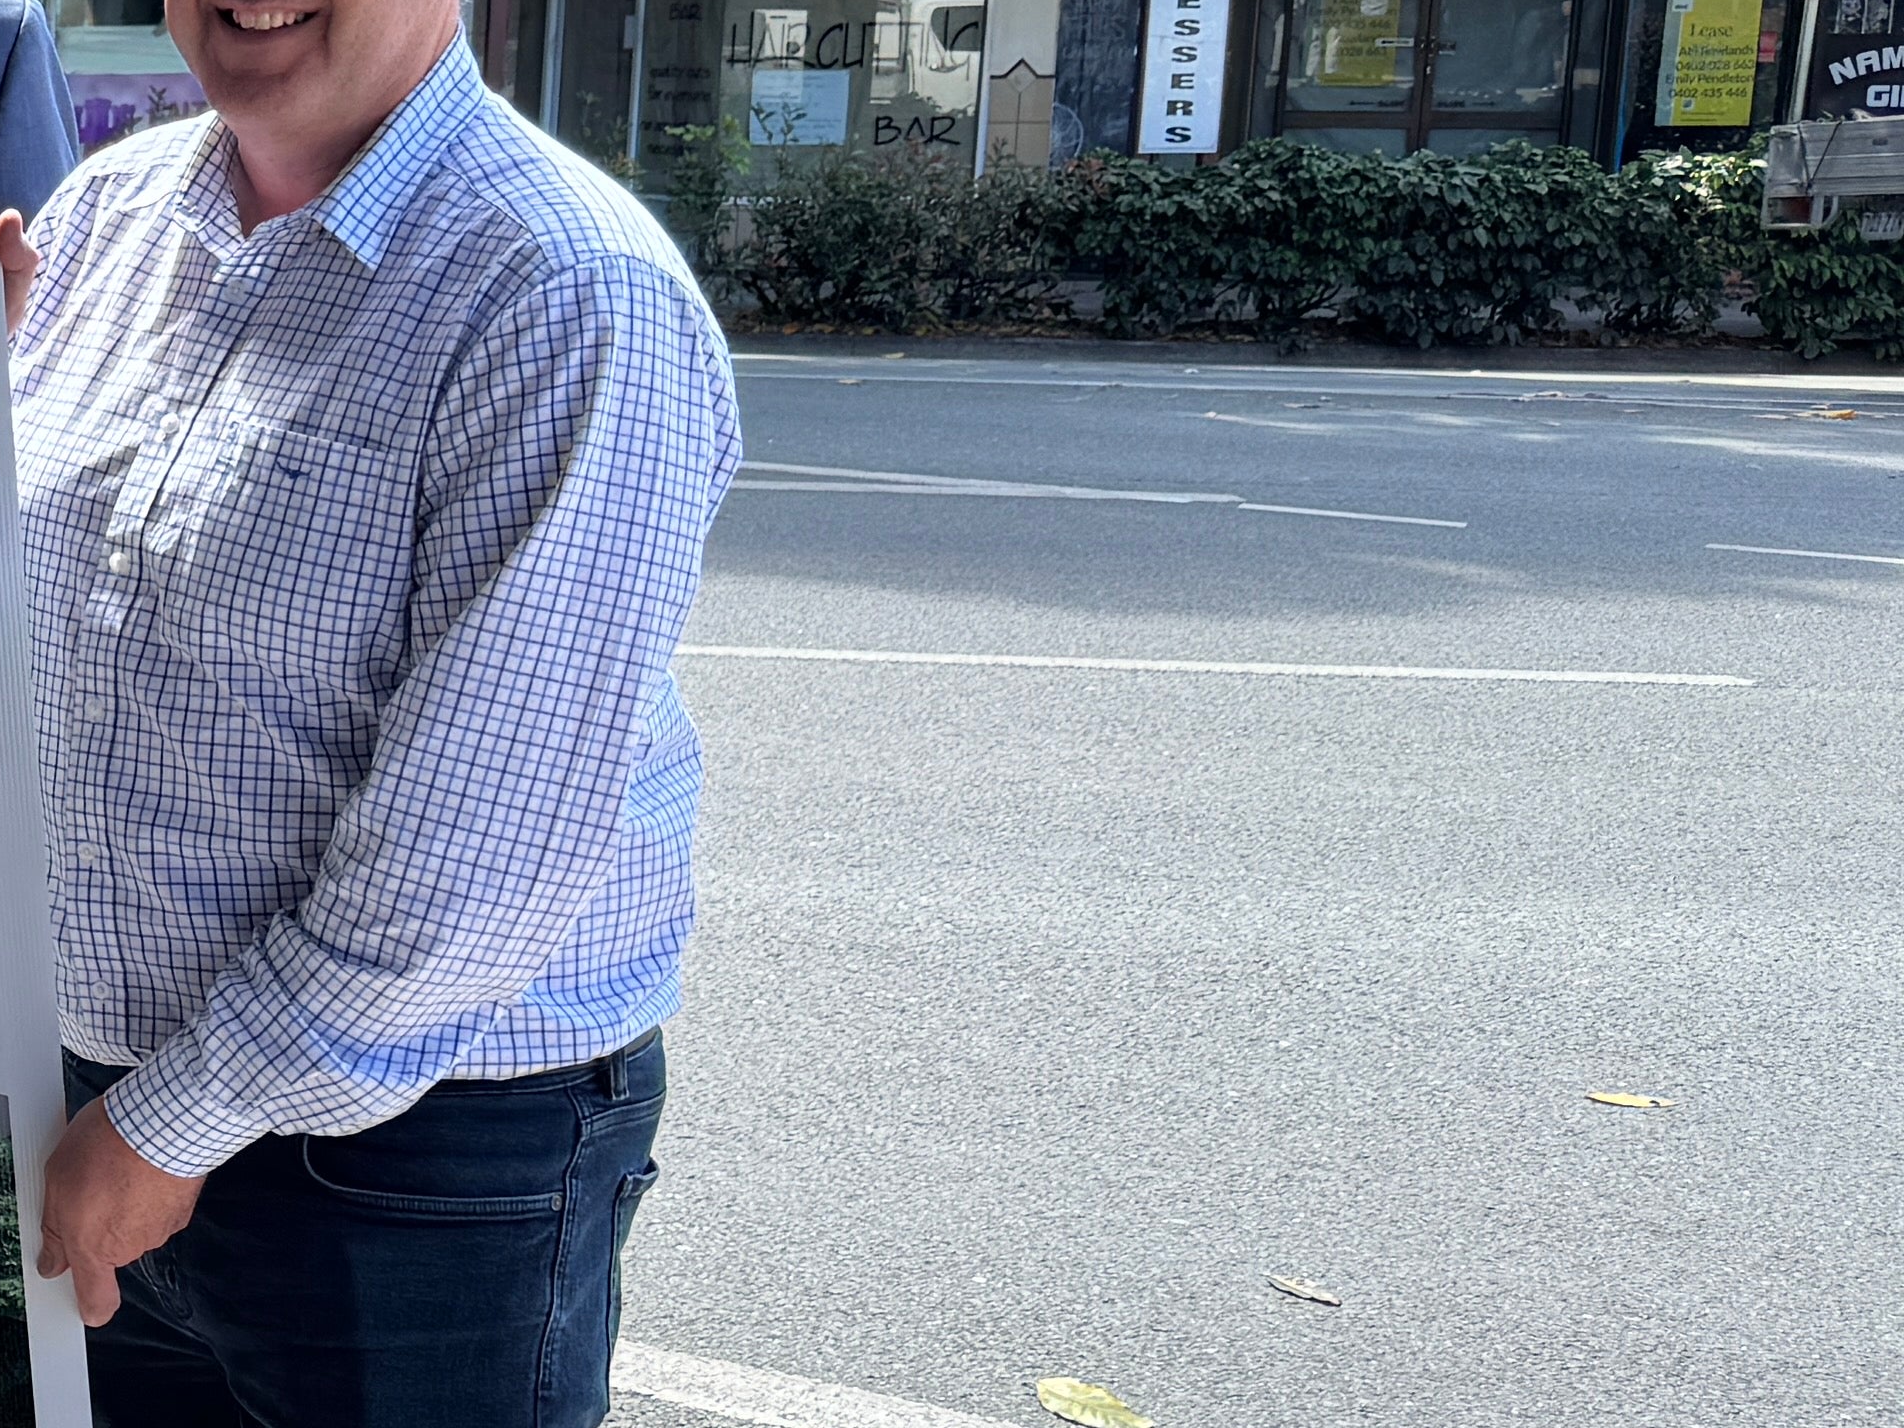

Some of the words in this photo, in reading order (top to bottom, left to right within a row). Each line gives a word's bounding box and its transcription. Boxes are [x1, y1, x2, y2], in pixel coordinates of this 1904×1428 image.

[1689, 23, 1734, 38] Lease
[725, 9, 980, 82] HAIRCUTTING
[1665, 73, 1696, 84] Emily
[873, 115, 961, 145] BAR
